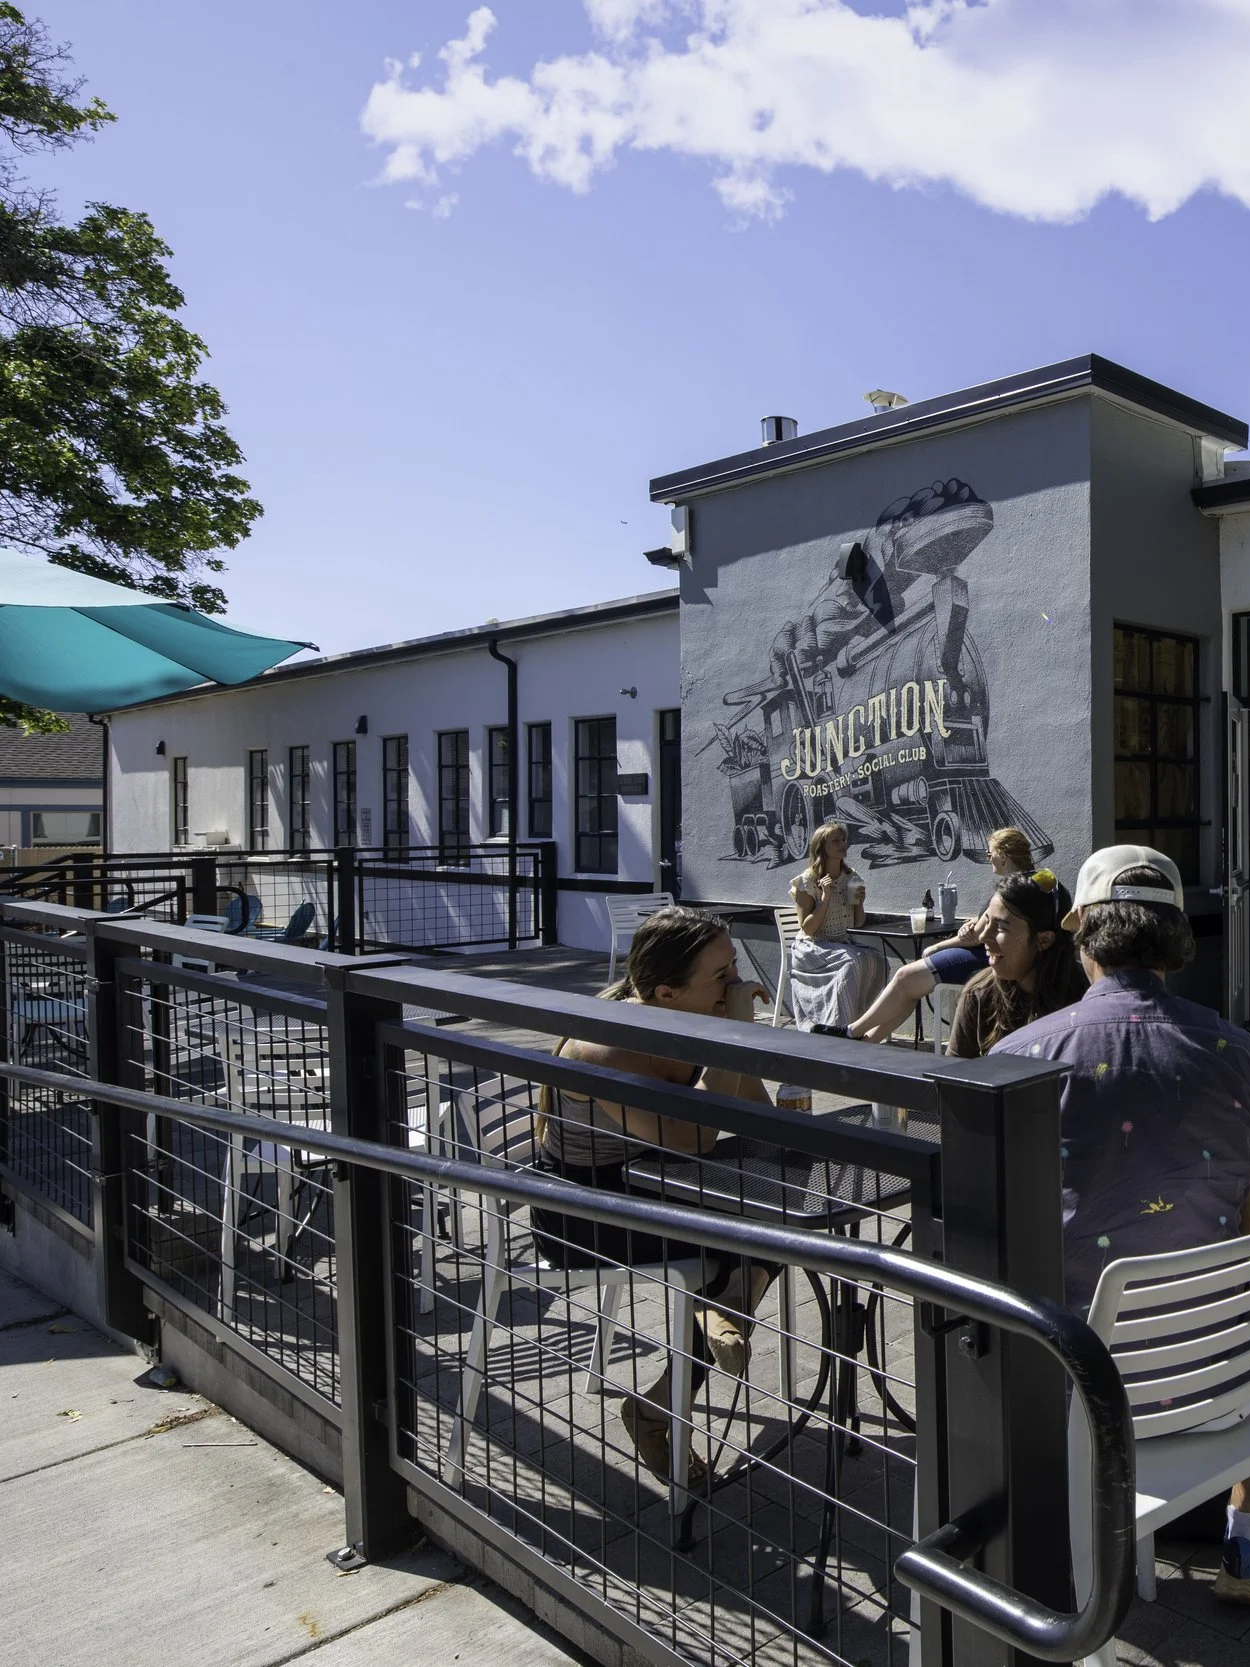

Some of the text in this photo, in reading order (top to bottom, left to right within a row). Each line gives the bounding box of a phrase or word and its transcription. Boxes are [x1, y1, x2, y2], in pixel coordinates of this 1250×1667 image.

[781, 680, 951, 780] JUNCTION
[804, 747, 927, 797] ROASTERY SOCIAL CLUB
